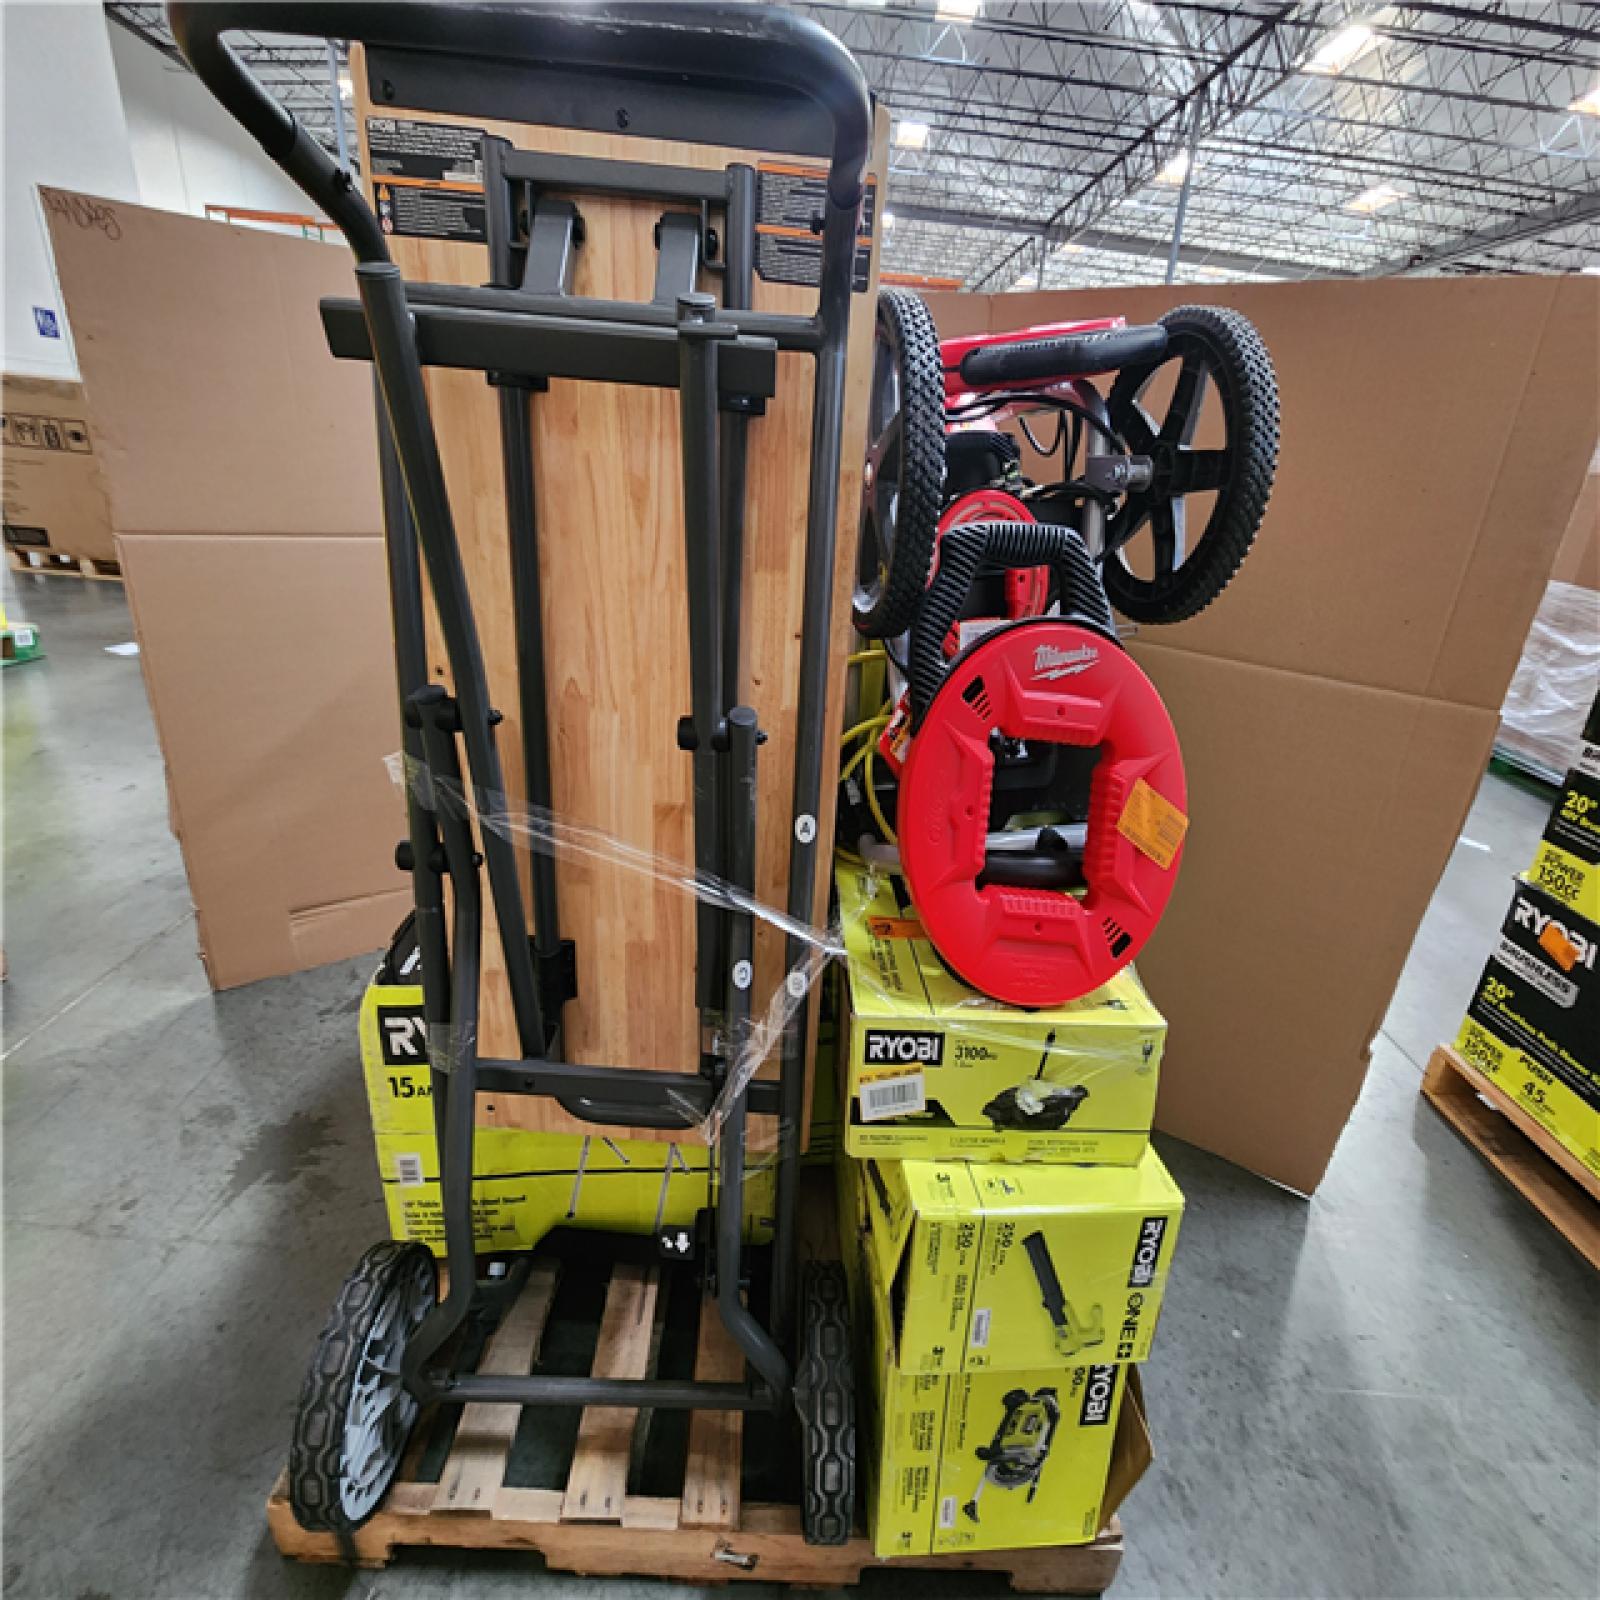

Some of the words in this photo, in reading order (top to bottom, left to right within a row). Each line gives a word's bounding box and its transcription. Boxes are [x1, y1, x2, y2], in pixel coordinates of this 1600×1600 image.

[869, 1034, 939, 1061] RYOBI
[388, 1077, 414, 1099] 15
[1132, 1219, 1164, 1284] RYOBI
